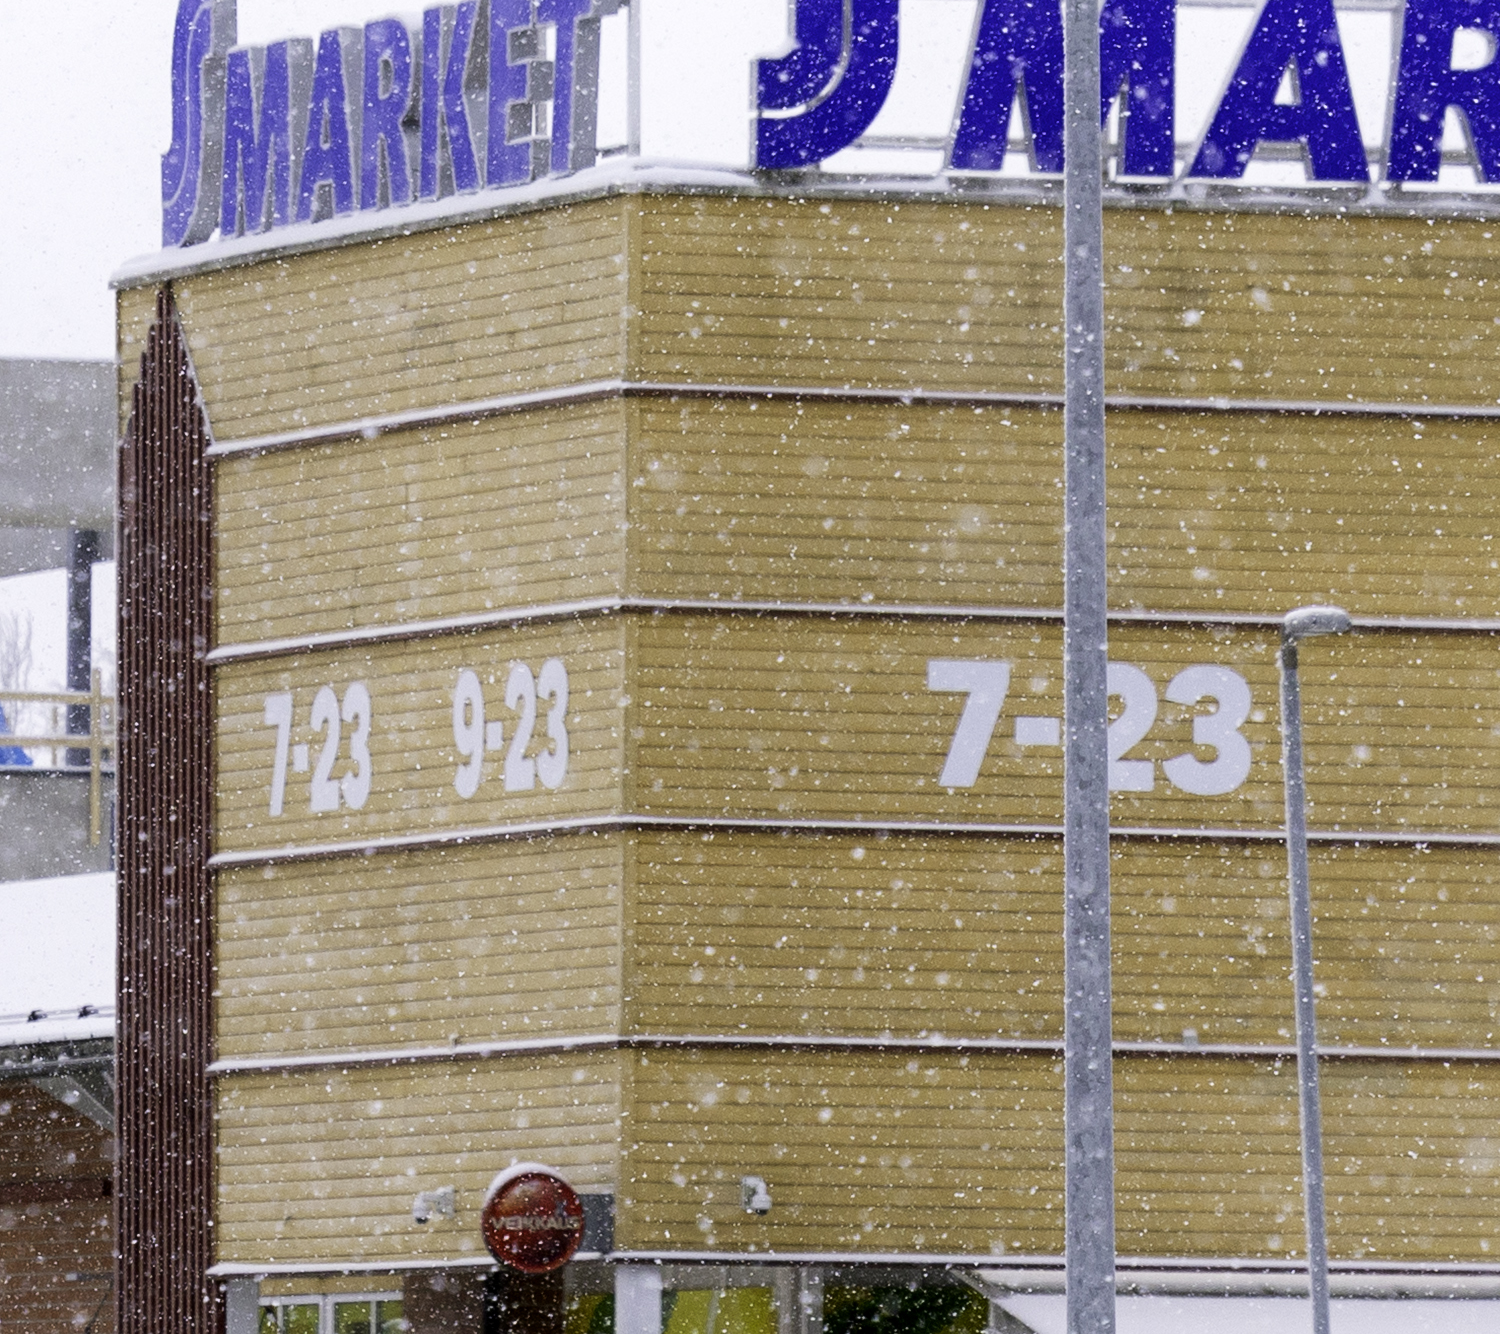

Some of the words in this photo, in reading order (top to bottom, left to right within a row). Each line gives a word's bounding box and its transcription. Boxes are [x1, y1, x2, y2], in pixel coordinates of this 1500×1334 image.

[264, 680, 372, 818] 7-23
[453, 657, 569, 799] 9-23
[926, 659, 1252, 797] 7-23
